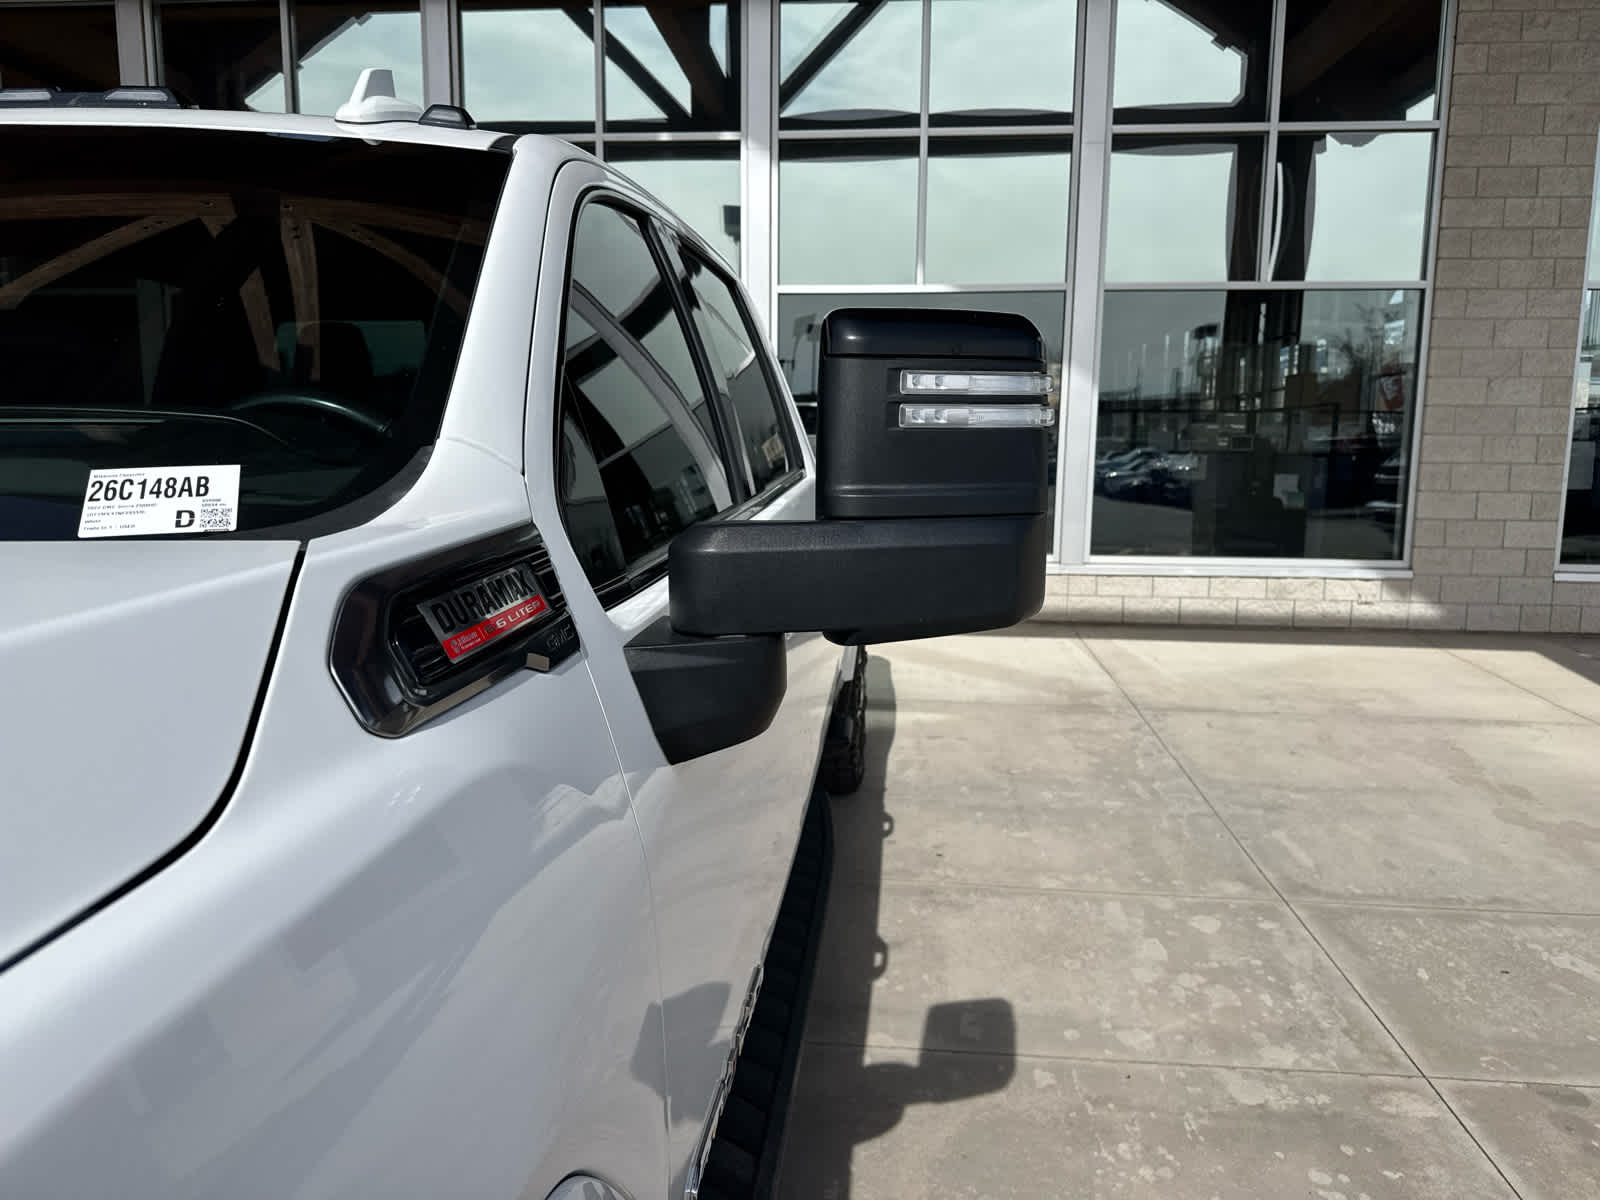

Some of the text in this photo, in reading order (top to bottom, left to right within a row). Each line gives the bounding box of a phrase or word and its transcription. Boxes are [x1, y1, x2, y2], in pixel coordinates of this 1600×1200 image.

[88, 476, 209, 502] 26C148AB
[175, 510, 195, 529] D
[431, 569, 535, 633] DURAMAX
[508, 601, 541, 622] LITER
